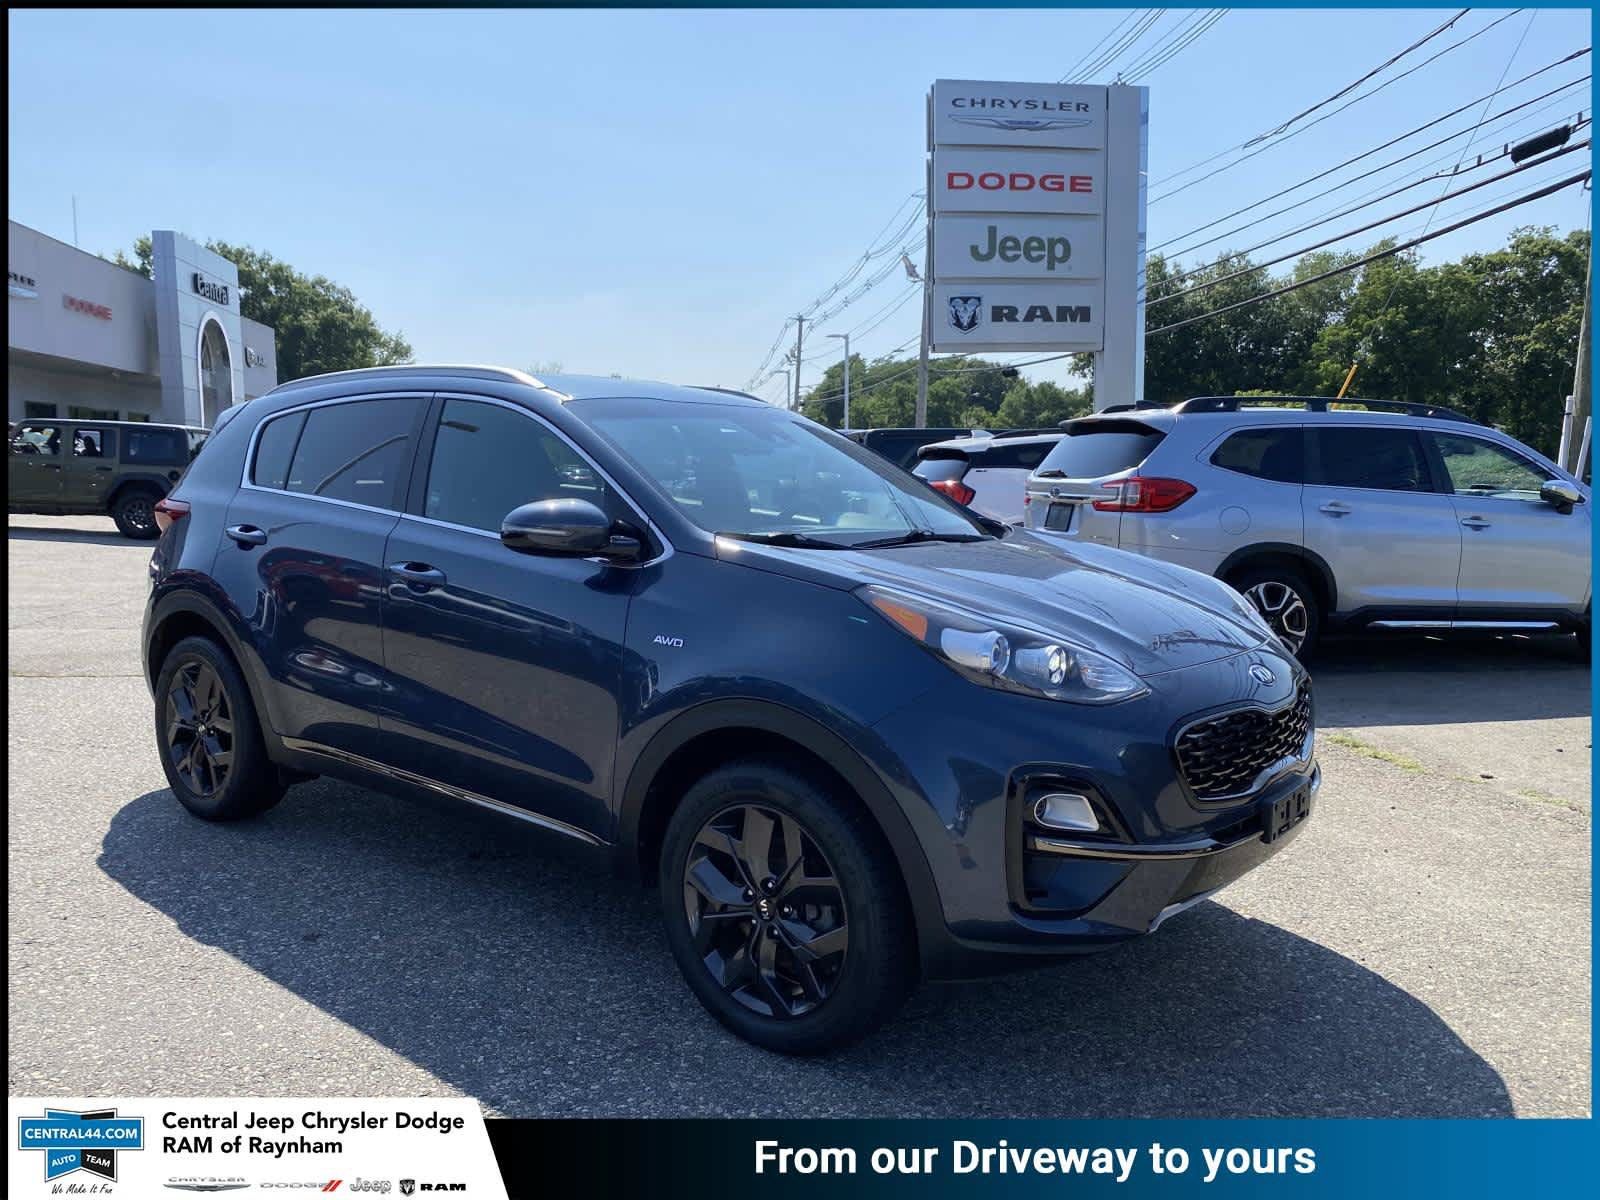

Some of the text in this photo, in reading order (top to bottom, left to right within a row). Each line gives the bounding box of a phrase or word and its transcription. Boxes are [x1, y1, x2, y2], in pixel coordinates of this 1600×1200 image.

[951, 97, 1090, 113] CHRYSLER
[947, 172, 1093, 193] DODGE
[969, 225, 1072, 271] Jeep
[192, 272, 230, 305] Central
[991, 305, 1091, 323] RAM
[653, 635, 684, 648] AWD
